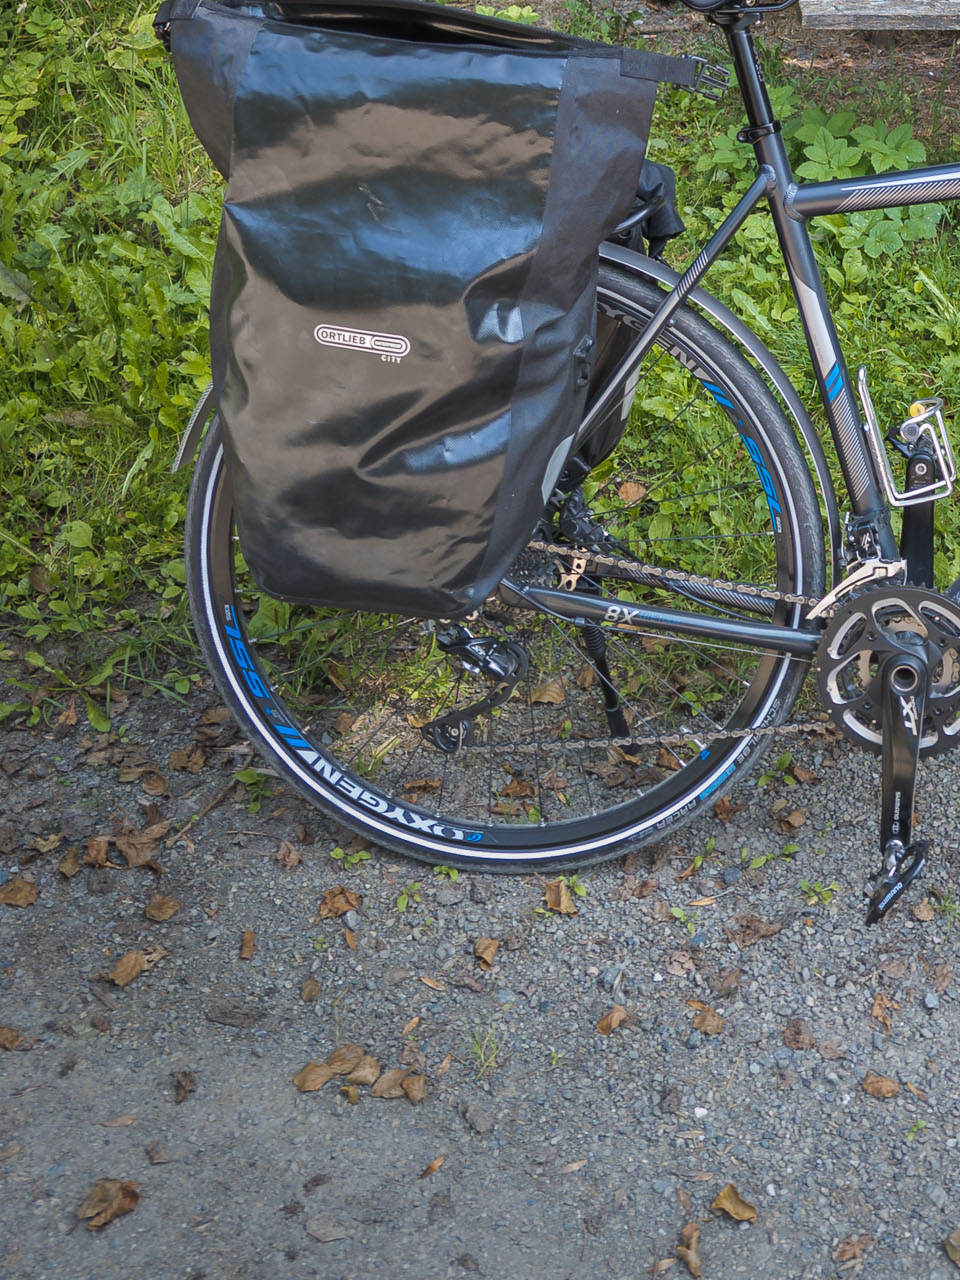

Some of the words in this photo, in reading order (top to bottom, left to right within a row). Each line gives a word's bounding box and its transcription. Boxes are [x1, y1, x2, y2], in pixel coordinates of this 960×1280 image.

[320, 330, 366, 345] ORTLIEB
[381, 355, 402, 364] CITY
[740, 433, 782, 531] SSL
[604, 605, 640, 625] 8X
[224, 604, 271, 699] SSL
[313, 758, 464, 841] OXYGEN
